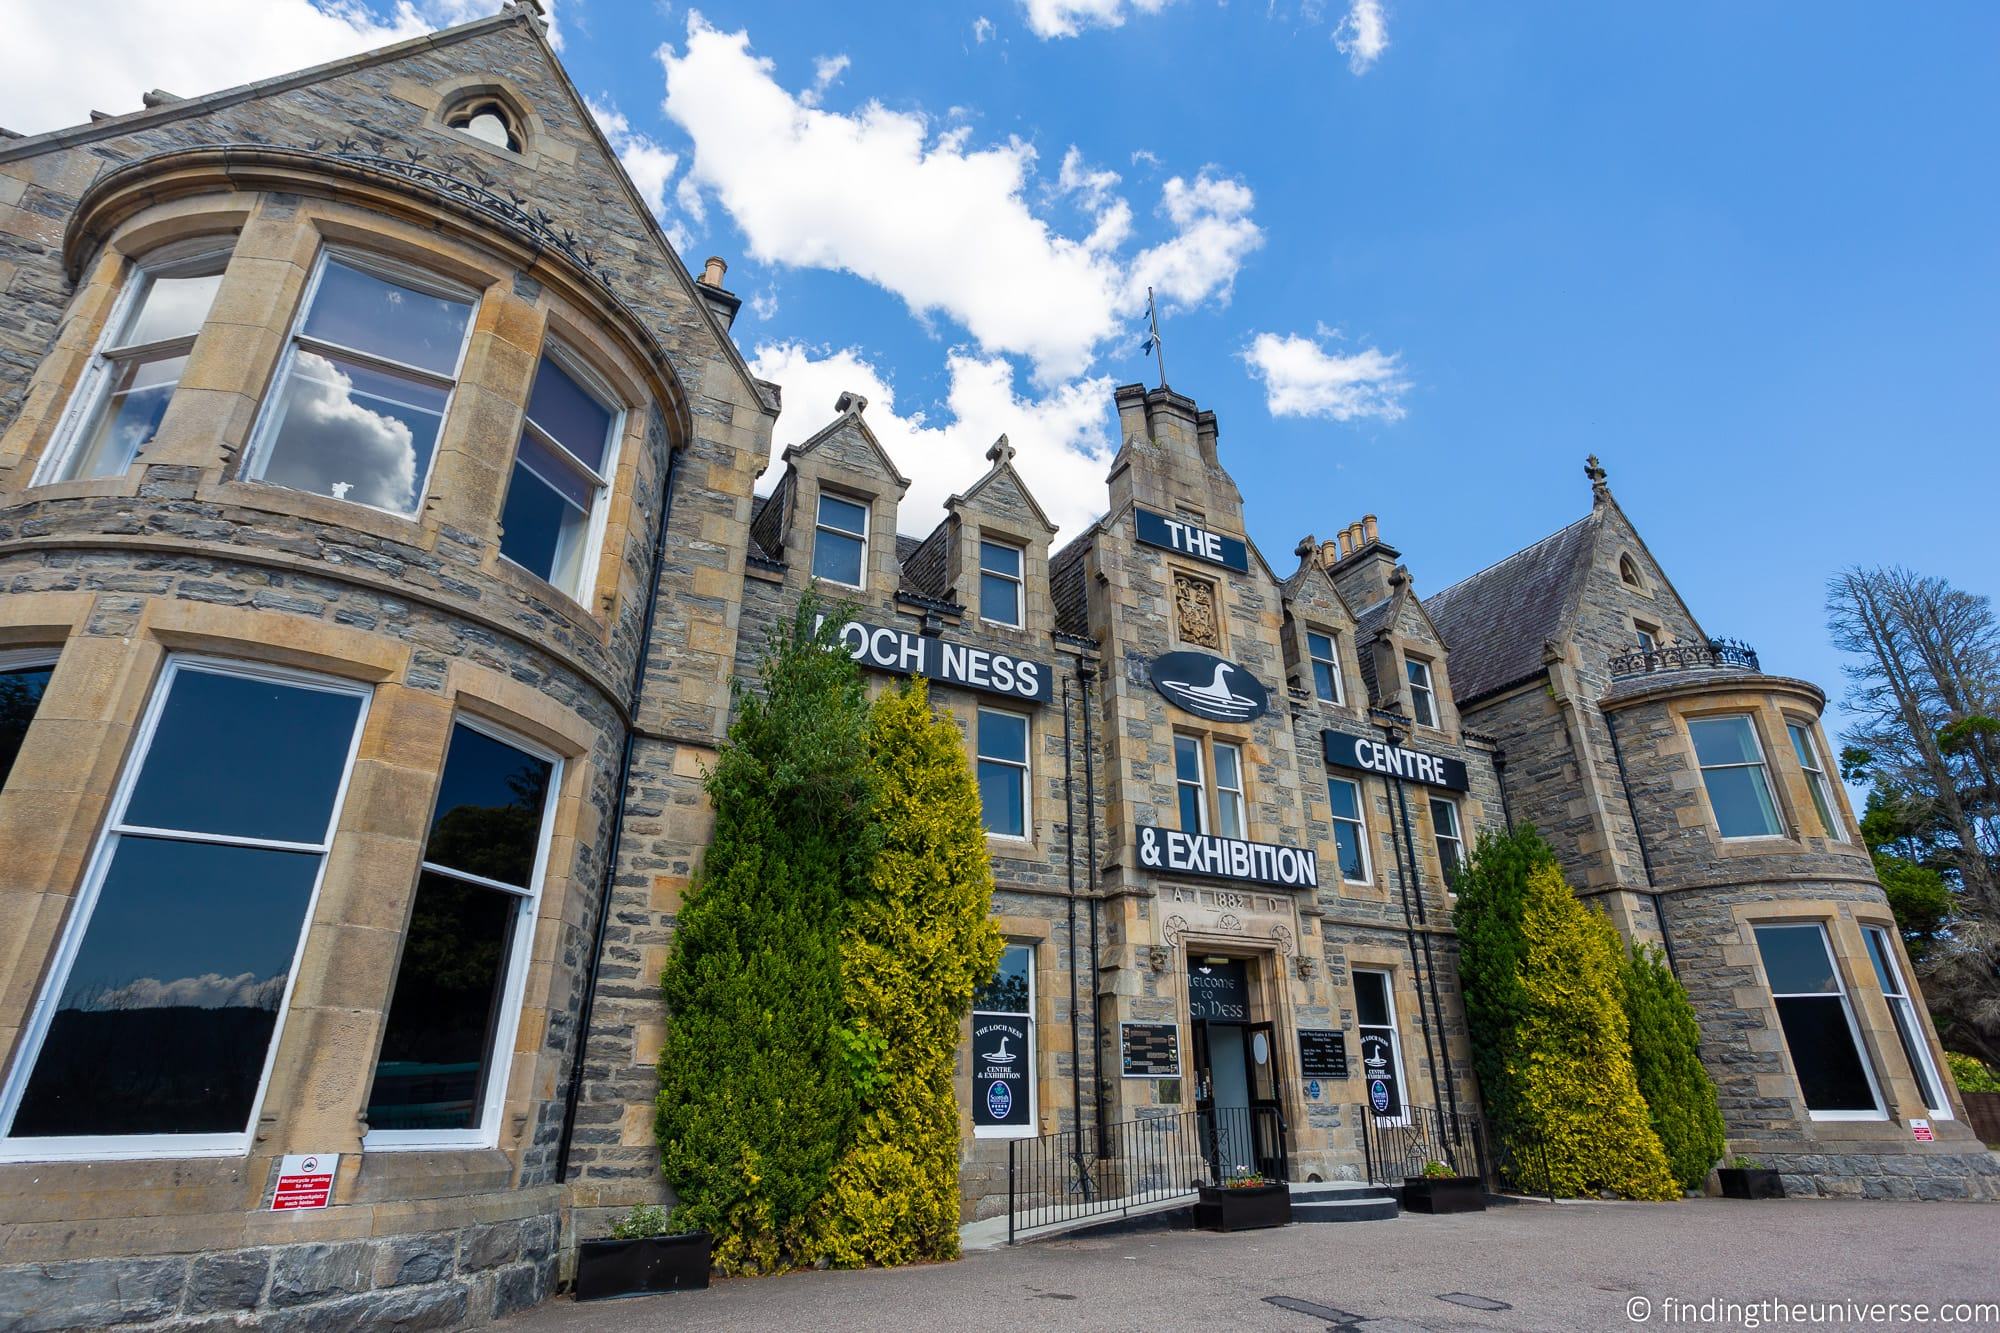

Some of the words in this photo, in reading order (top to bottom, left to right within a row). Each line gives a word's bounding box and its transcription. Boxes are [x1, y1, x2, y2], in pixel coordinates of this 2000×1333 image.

[1163, 519, 1224, 562] THE
[942, 643, 1039, 697] NESS
[1354, 738, 1447, 785] CENTRE
[1140, 827, 1163, 867] &
[1167, 831, 1317, 886] EXHIBITION
[1173, 887, 1184, 904] A
[1213, 891, 1245, 909] 1882
[1268, 898, 1278, 913] D
[1201, 990, 1214, 1000] to
[975, 1026, 989, 1038] THE
[989, 1024, 1007, 1032] LOCH
[1008, 1026, 1024, 1039] NESS
